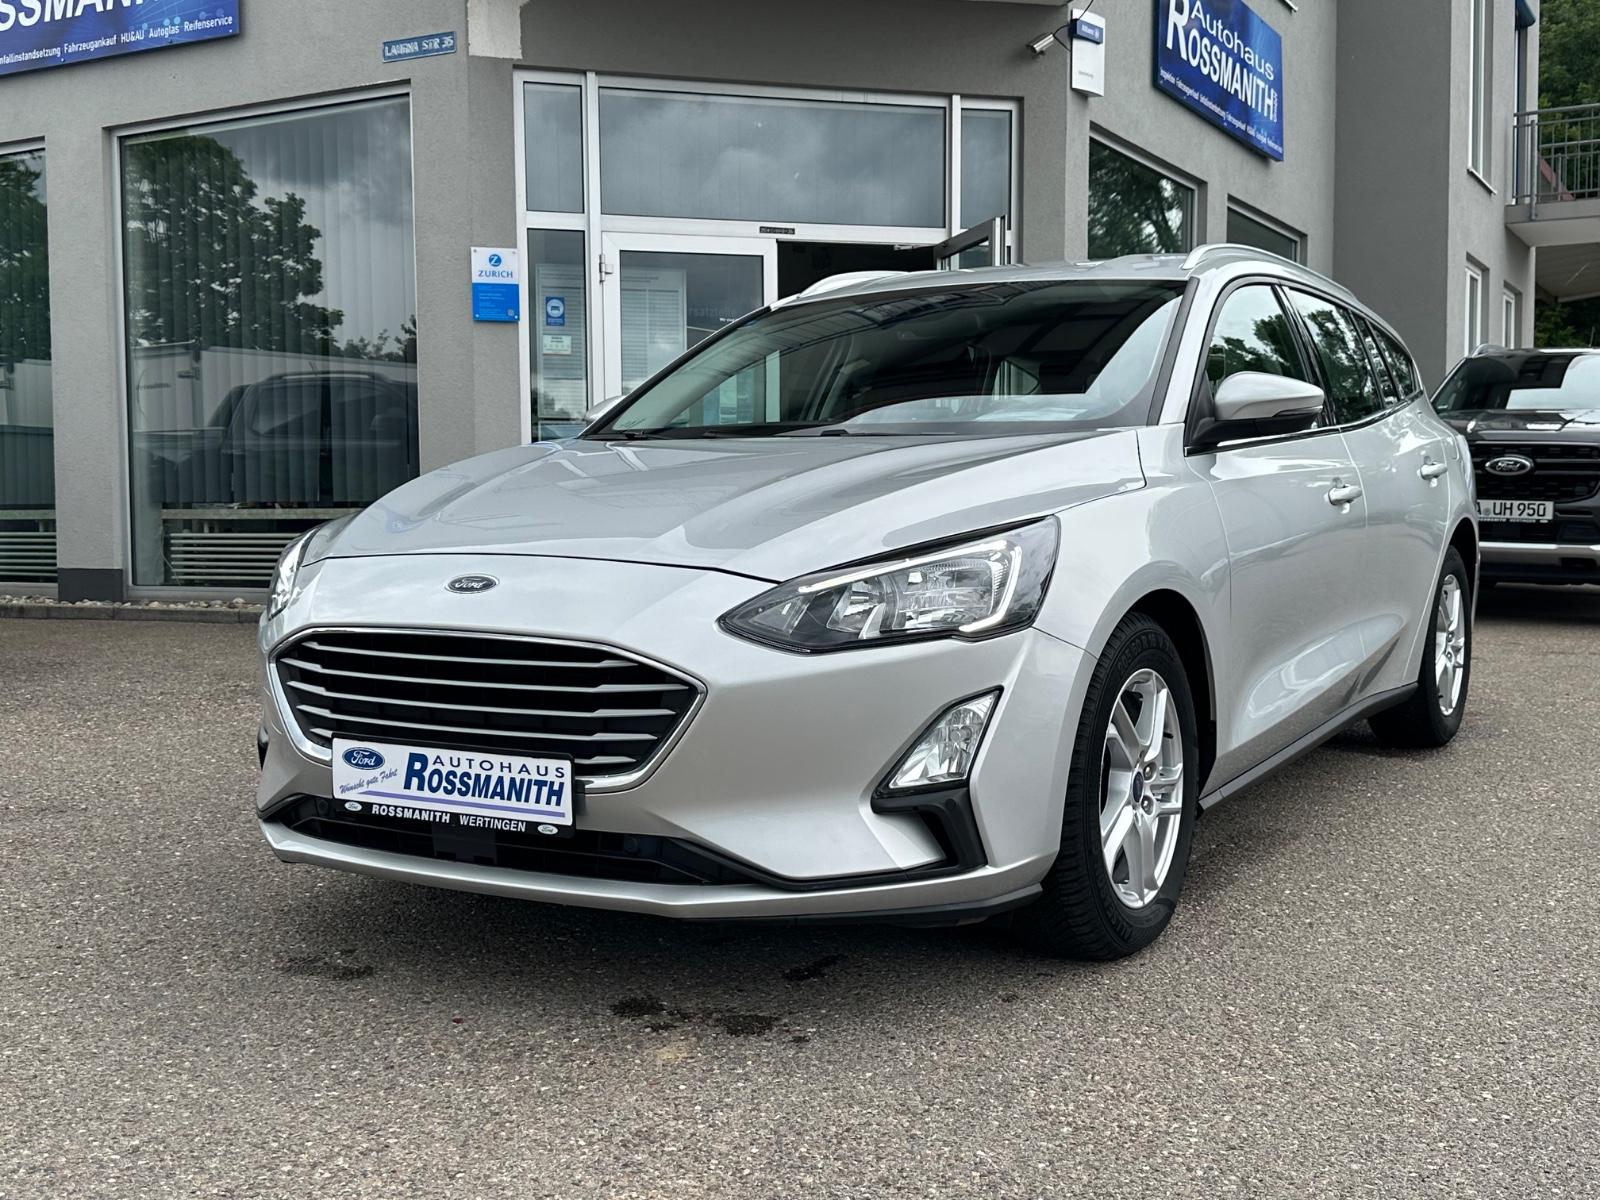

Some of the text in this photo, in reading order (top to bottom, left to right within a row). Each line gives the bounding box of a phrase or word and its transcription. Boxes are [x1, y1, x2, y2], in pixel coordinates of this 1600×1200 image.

[64, 34, 117, 54] Fahrzeugankauf
[120, 30, 145, 44] HU&AU
[149, 25, 180, 39] Autoglas
[184, 15, 233, 32] Reifenservice
[1191, 0, 1274, 80] Autohaus
[478, 270, 513, 278] ZURICH
[1495, 461, 1520, 471] Ford
[1493, 502, 1513, 516] UH
[1517, 502, 1546, 517] 950
[350, 750, 377, 766] Ford
[432, 755, 565, 778] AUTOHAUS
[403, 752, 564, 806] ROSSMANITH
[371, 804, 527, 832] ROSSMANITH WERTINGEN
